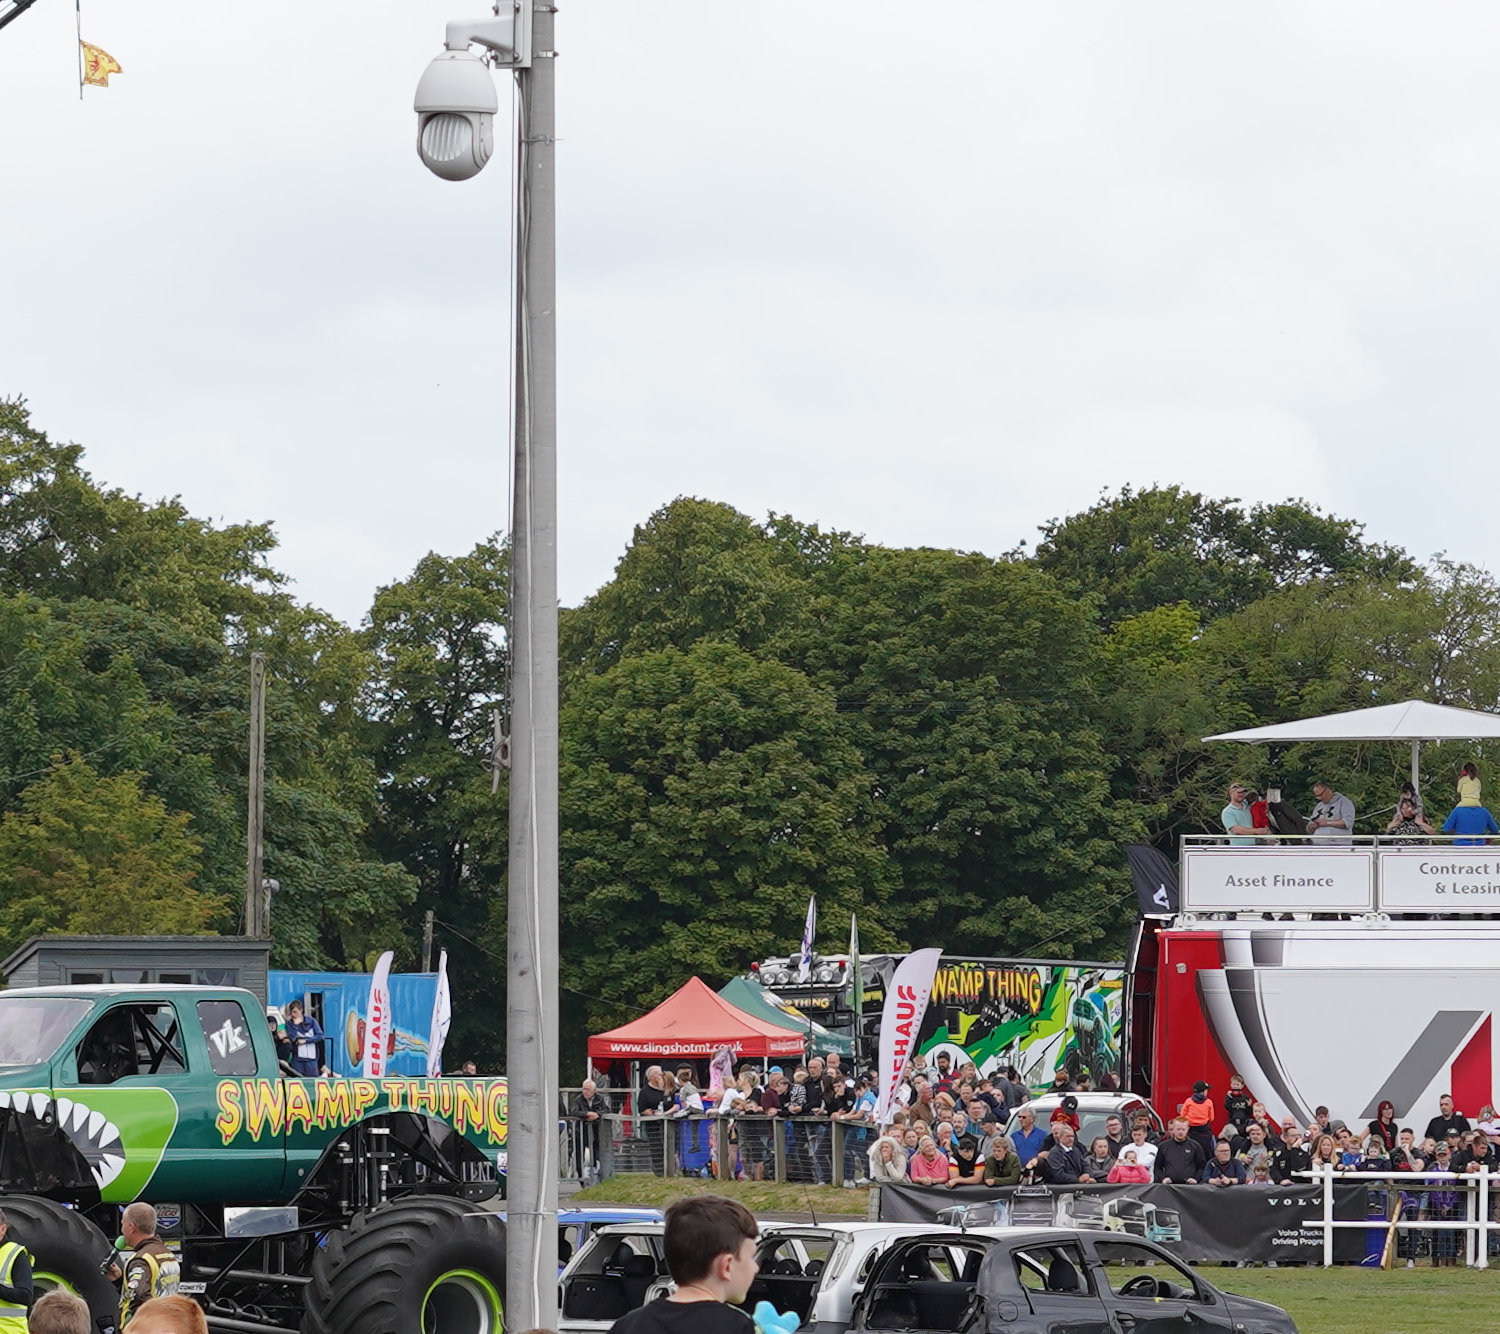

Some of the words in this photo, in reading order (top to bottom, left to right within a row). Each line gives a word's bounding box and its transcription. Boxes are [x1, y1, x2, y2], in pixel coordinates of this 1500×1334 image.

[1419, 862, 1490, 875] Contract
[1225, 874, 1267, 888] Asset
[1273, 874, 1334, 888] Finance
[1435, 882, 1447, 894] &
[987, 969, 1042, 1015] THING
[215, 1078, 378, 1147] SWAMP
[381, 1079, 508, 1146] THING
